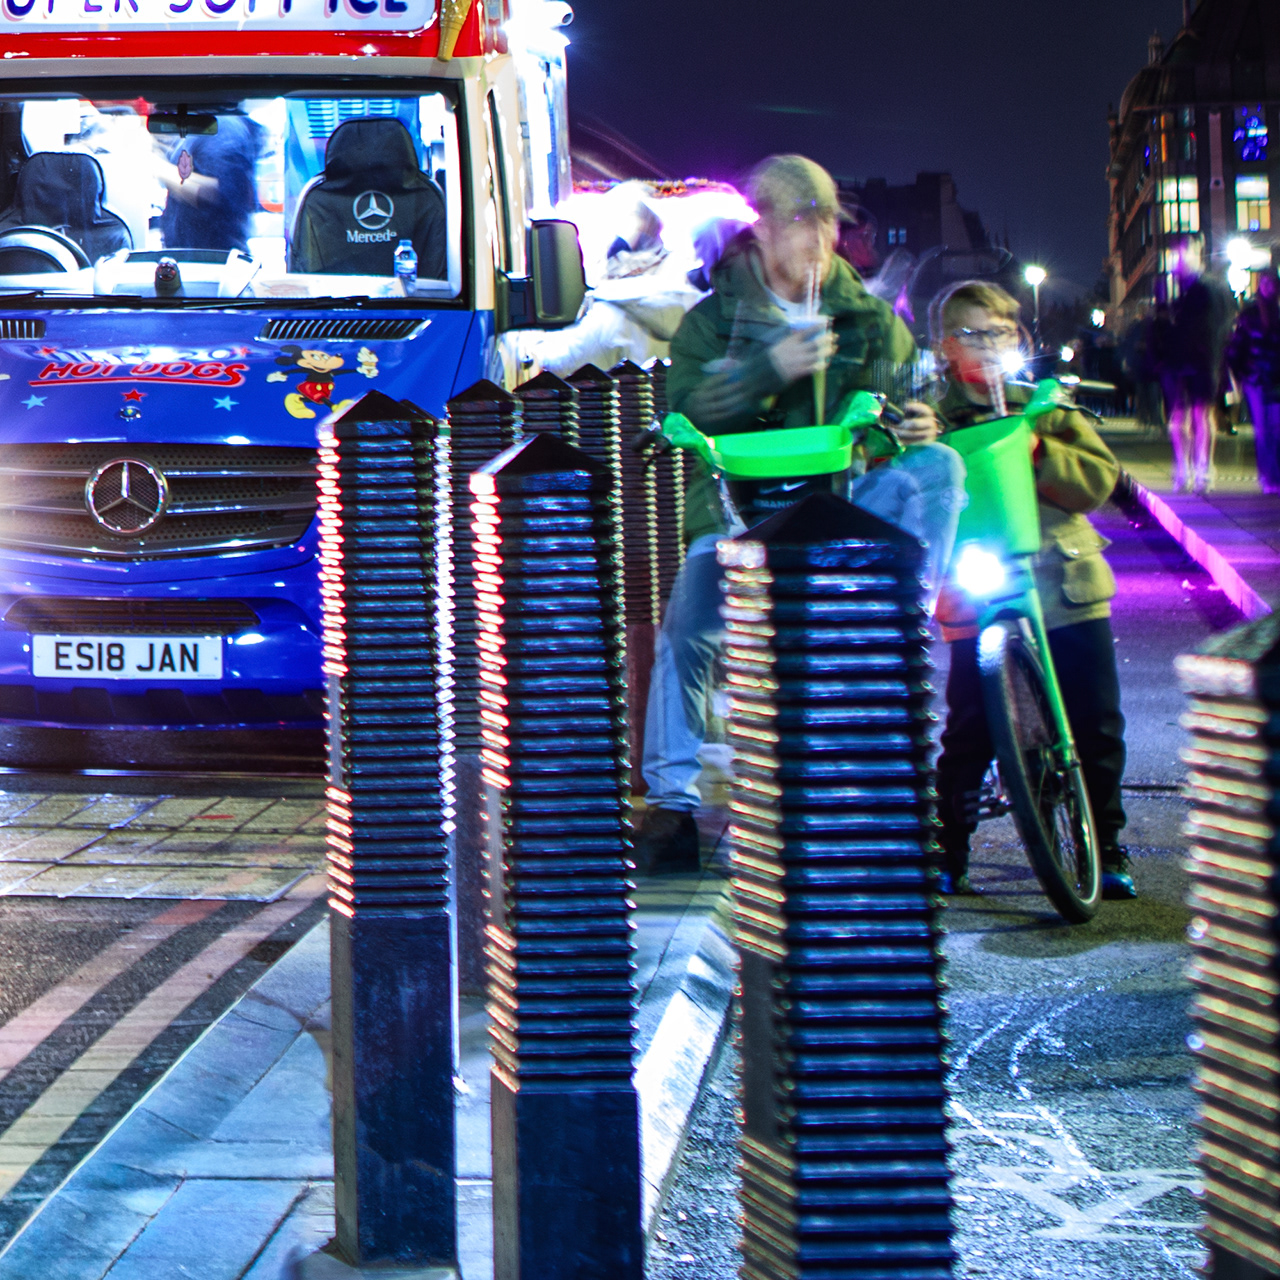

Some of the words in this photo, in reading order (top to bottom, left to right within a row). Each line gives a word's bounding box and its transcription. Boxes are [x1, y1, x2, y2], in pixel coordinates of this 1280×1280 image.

[129, 361, 250, 387] DOGS
[54, 641, 125, 671] ES18
[136, 643, 199, 673] JAN
